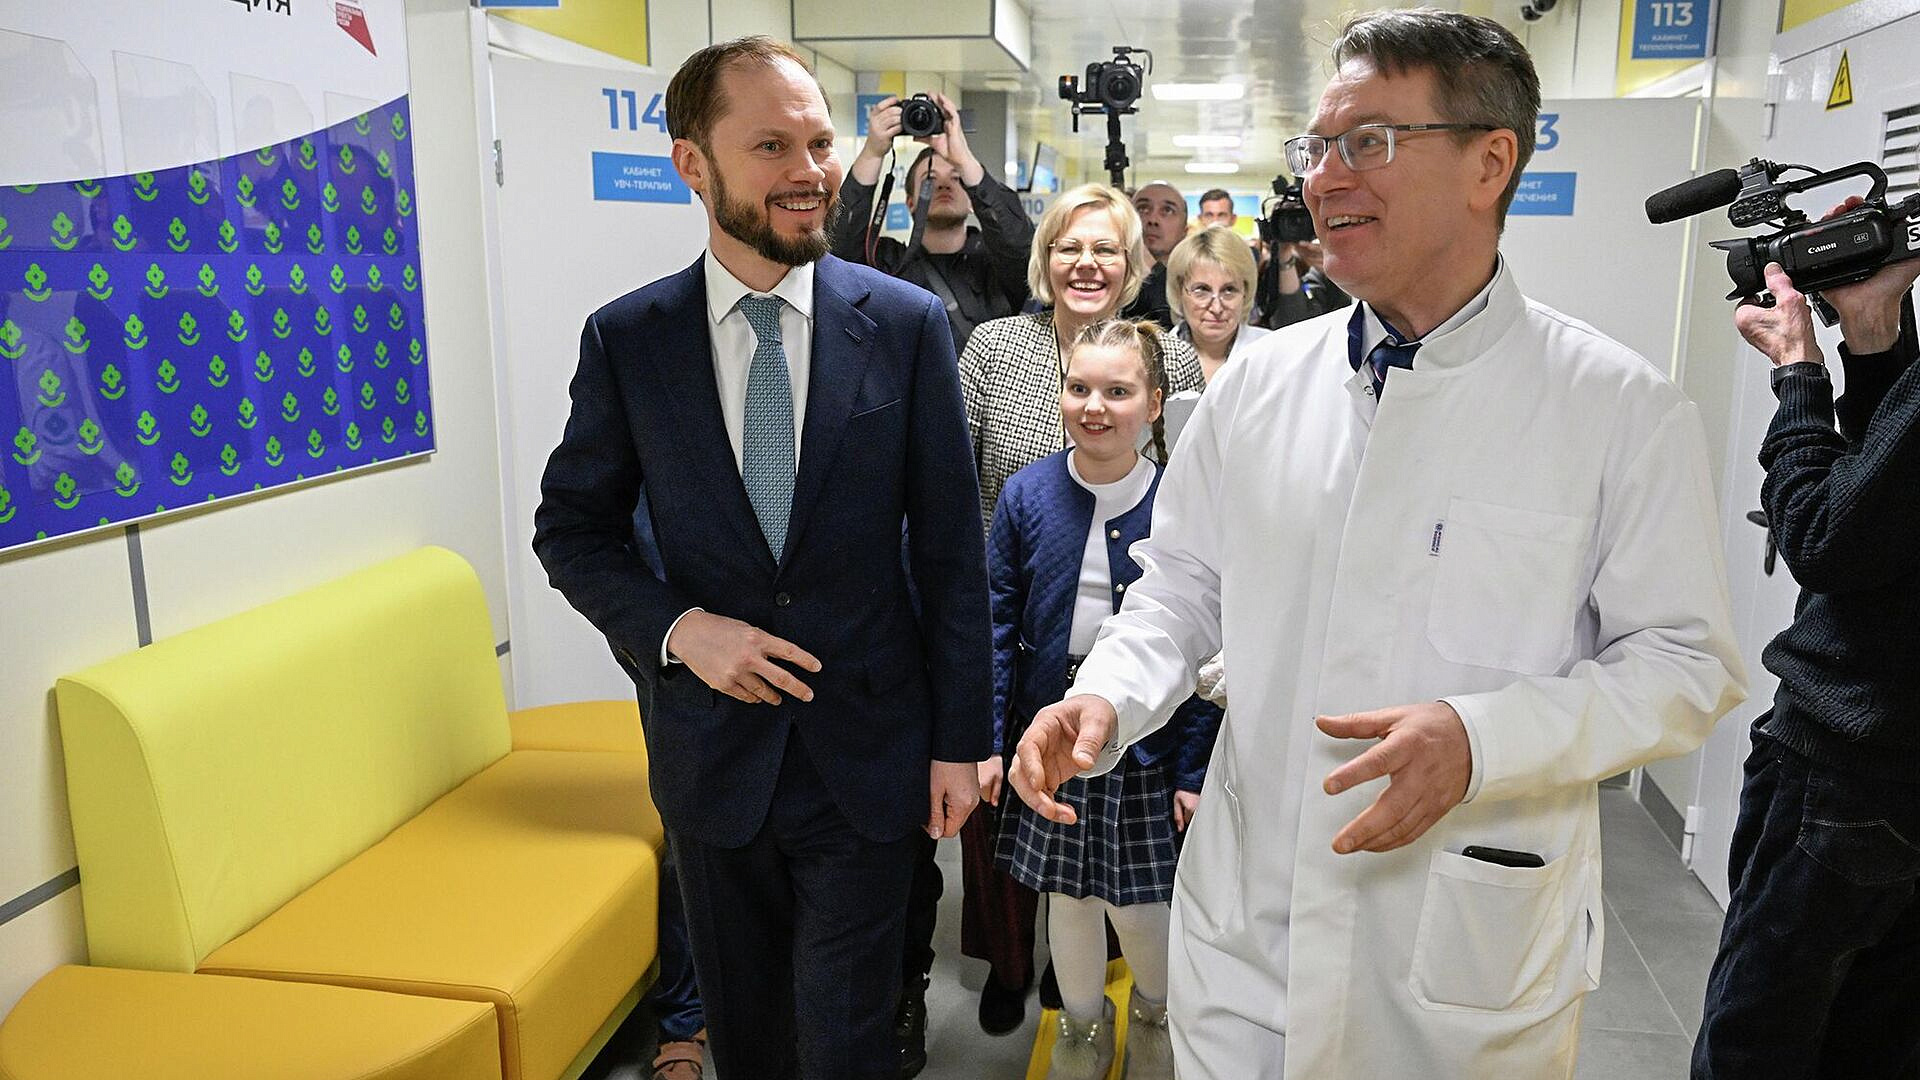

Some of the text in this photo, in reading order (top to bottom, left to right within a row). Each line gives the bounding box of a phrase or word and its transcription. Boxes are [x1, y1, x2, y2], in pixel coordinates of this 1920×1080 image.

[1650, 2, 1694, 27] 113
[602, 88, 667, 134] 114
[623, 166, 663, 177] КАБИНЕТ
[614, 180, 672, 191] УВЧ-ТЕРАПИИ
[1807, 242, 1837, 254] Canon
